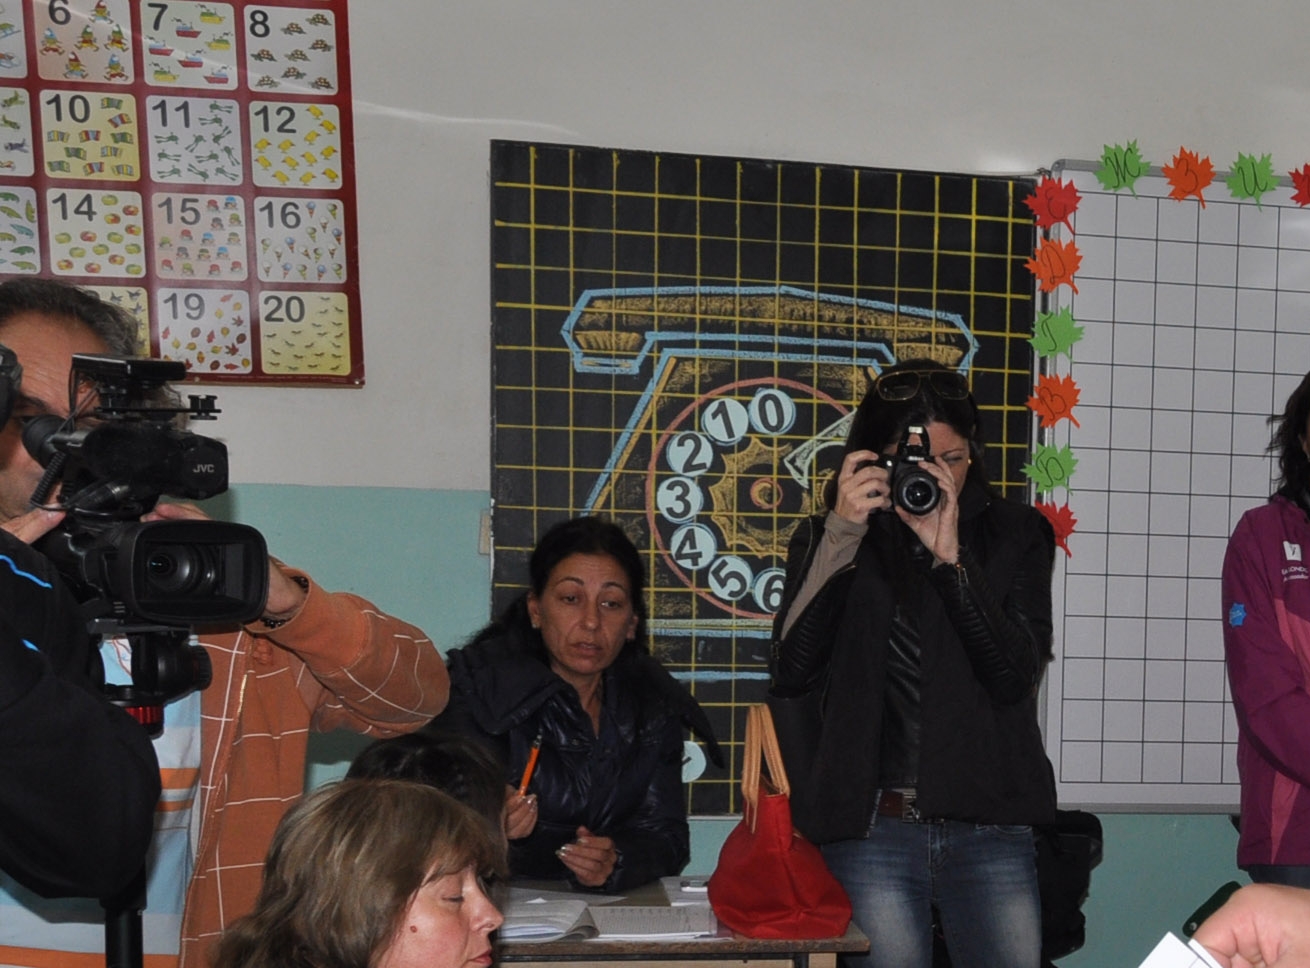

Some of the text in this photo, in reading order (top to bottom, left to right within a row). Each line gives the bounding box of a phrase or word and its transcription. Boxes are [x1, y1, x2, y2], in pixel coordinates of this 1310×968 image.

[48, 0, 270, 37] 6 7 8
[46, 94, 296, 133] 10 11 12
[52, 193, 301, 229] 14 15 16
[163, 292, 305, 322] 19 20
[711, 400, 735, 438] 1
[758, 393, 786, 433] 0
[193, 464, 215, 473] JVC
[677, 433, 707, 473] 2
[666, 480, 692, 519] 3
[676, 528, 702, 567] 4
[711, 559, 747, 597] 5
[762, 573, 785, 612] 6
